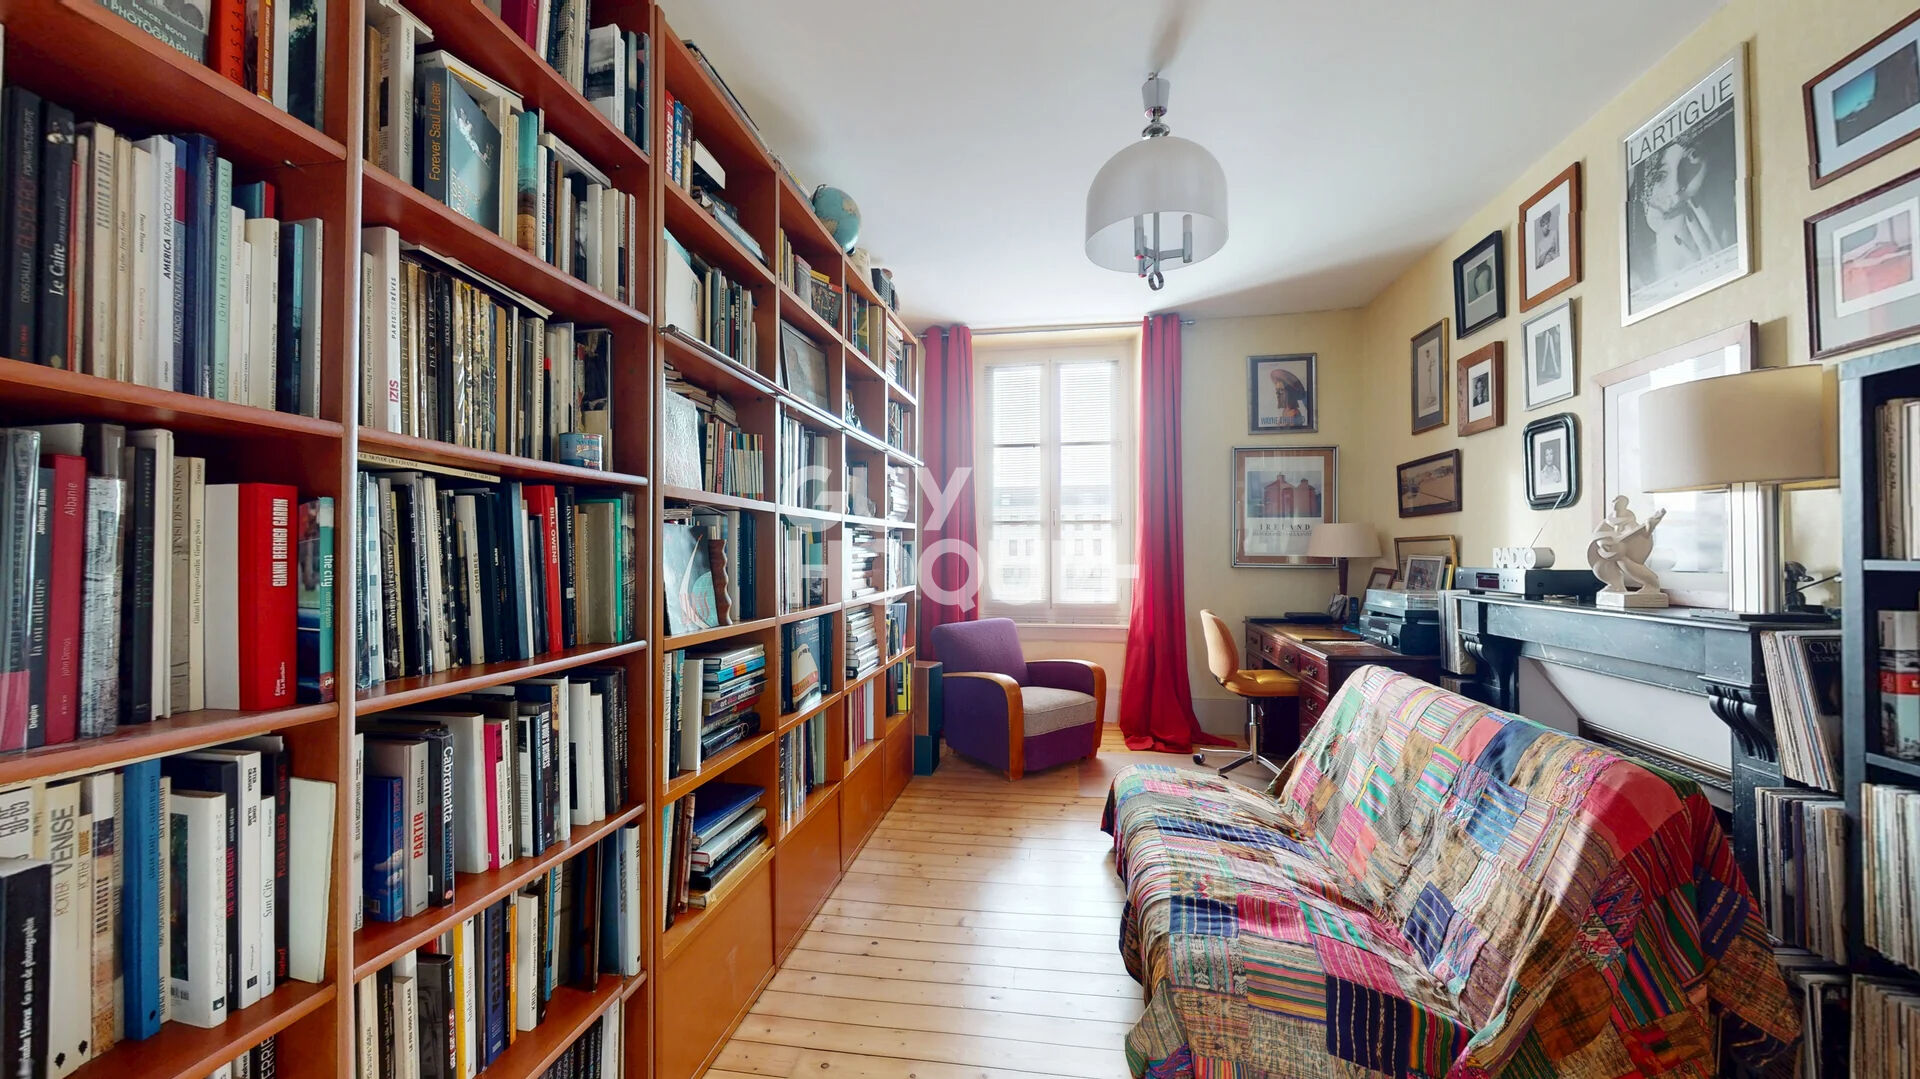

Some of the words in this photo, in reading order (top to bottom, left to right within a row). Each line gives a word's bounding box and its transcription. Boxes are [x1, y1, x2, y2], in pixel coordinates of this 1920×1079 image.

[428, 114, 441, 138] Saul
[1630, 72, 1734, 166] LARTIGUE
[428, 140, 441, 181] Forever
[665, 126, 674, 176] MOSCOU
[163, 203, 172, 238] FRANCO
[48, 246, 66, 279] Caire
[163, 240, 172, 280] AMERICA
[48, 281, 64, 298] Le
[173, 271, 183, 313] FONTANA
[219, 294, 227, 324] JOHN
[428, 345, 436, 368] DES
[389, 380, 399, 404] IZIS
[37, 488, 48, 506] Baak
[64, 482, 77, 516] Albanie
[172, 464, 183, 503] SAISONS
[272, 498, 288, 526] GARDIN
[565, 505, 573, 534] STRAND
[1259, 523, 1311, 531] IRELAND
[272, 528, 288, 560] BERENGO
[445, 518, 453, 561] NAM
[323, 554, 333, 569] the
[387, 544, 395, 579] CARNETS
[472, 552, 480, 595] SOMBRES
[1492, 547, 1538, 568] RADIO
[272, 561, 288, 587] GIANNI
[321, 570, 333, 588] city
[31, 579, 45, 625] ailleurs
[193, 604, 201, 625] Gianni
[448, 584, 457, 641] VIET
[28, 703, 39, 729] Delpire
[443, 745, 454, 824] Cabramatta
[0, 800, 30, 838] 50-65
[412, 811, 424, 859] PARTIR
[51, 805, 74, 876] VENISE
[226, 846, 235, 899] STATEMENT
[263, 878, 274, 899] City
[226, 900, 235, 919] THE
[263, 900, 273, 918] Sun
[21, 917, 38, 968] photographie
[22, 968, 35, 980] de
[23, 979, 35, 993] ans
[19, 1007, 33, 1039] Horvat
